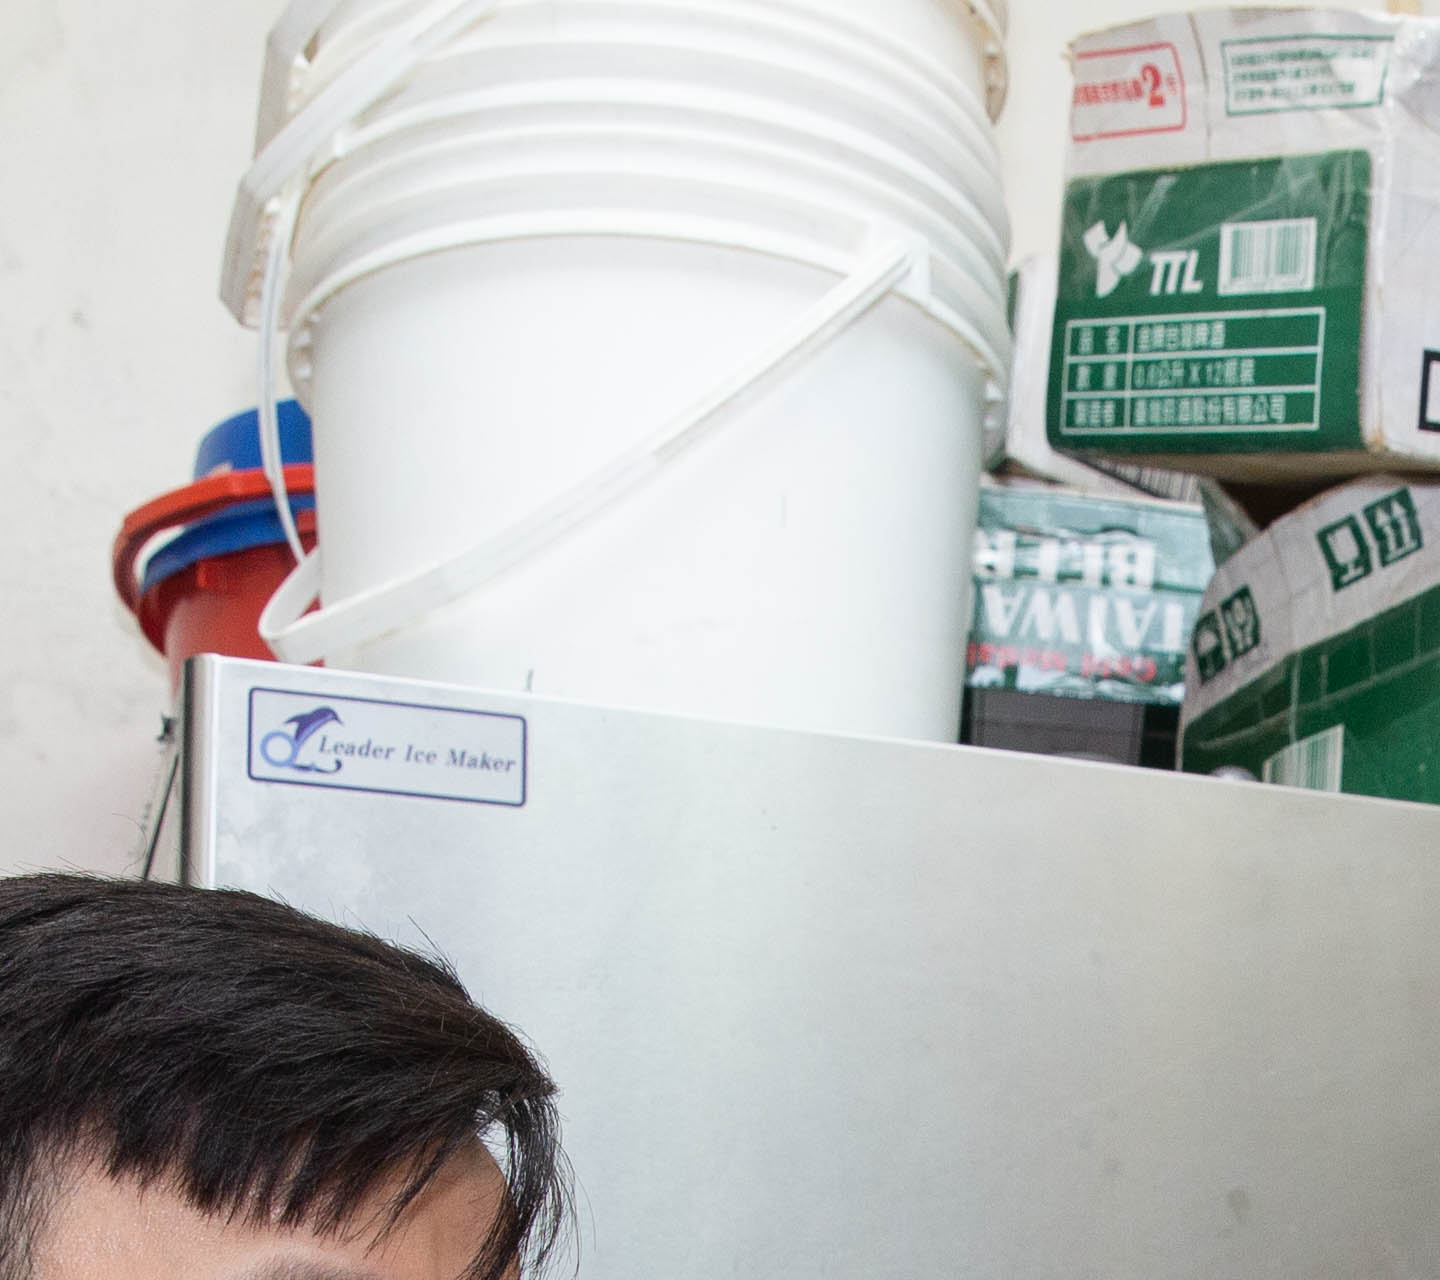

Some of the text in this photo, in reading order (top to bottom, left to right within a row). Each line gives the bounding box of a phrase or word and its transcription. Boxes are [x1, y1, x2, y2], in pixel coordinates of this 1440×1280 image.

[1149, 249, 1204, 297] TTL
[981, 584, 1185, 652] TAIWA
[318, 734, 517, 773] Leader Ice Maker
